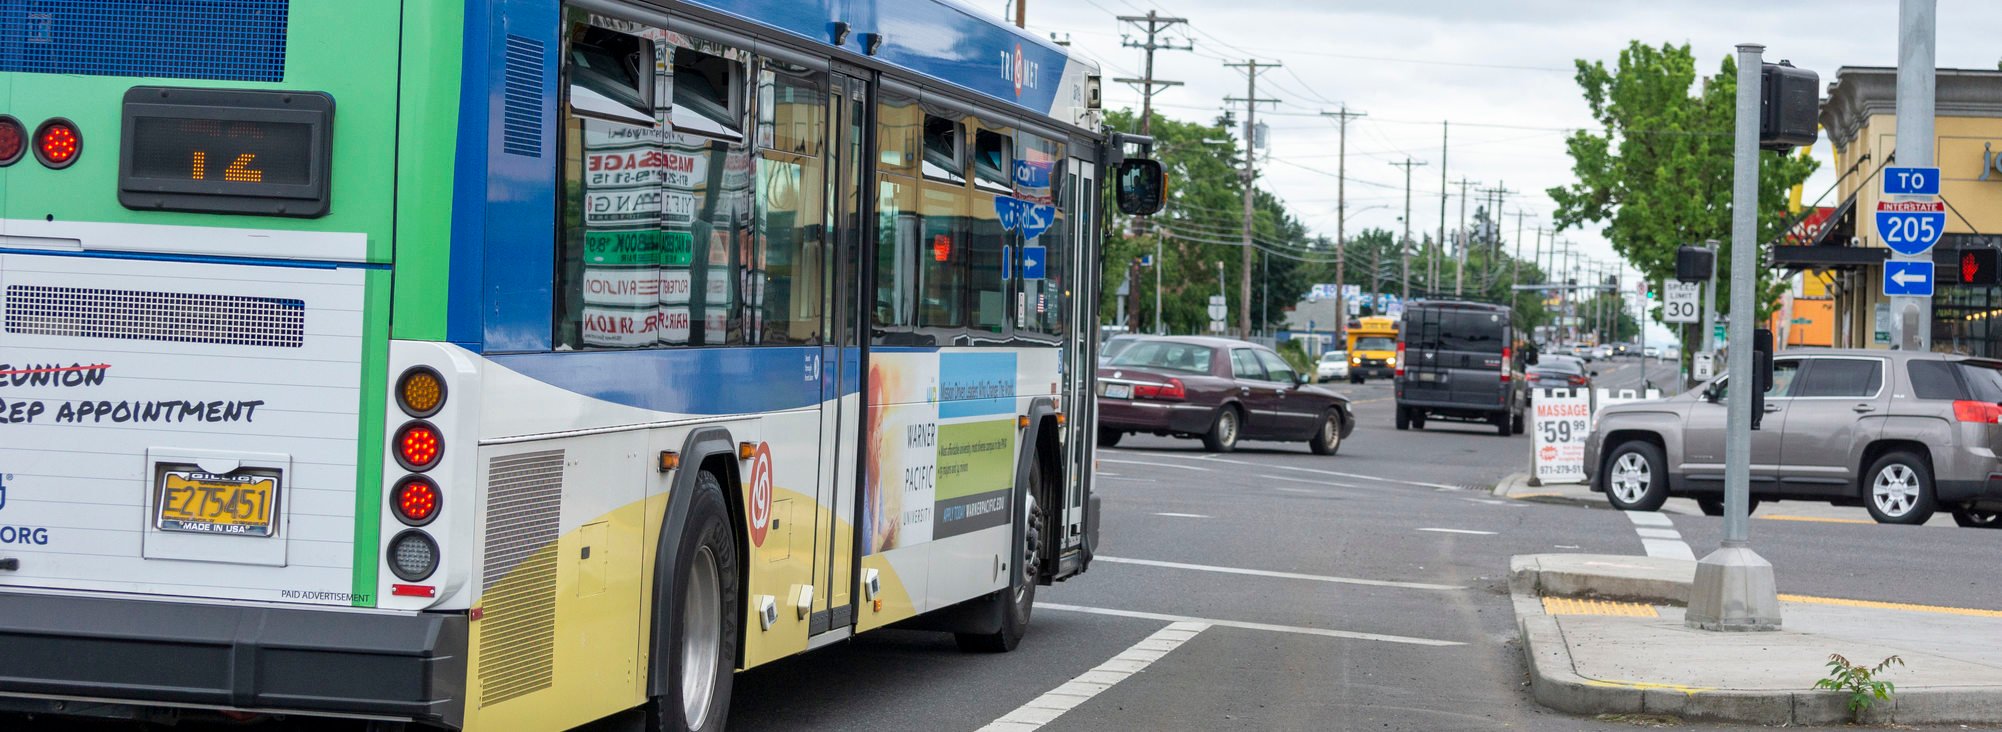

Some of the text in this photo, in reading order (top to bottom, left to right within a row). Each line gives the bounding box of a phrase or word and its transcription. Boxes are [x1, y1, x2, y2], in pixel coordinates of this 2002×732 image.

[1001, 50, 1039, 90] TRI MET
[1977, 142, 2002, 182] j
[1898, 173, 1925, 189] TO
[1883, 204, 1938, 212] INTERSTATE
[1887, 217, 1935, 242] 205
[1668, 302, 1694, 317] 30
[56, 400, 264, 424] APPOINTMENT
[1537, 404, 1588, 416] MASSAGE
[907, 423, 936, 448] WARNER
[905, 465, 934, 492] PACIFIC
[164, 486, 267, 520] E275451
[182, 521, 210, 531] MADE
[213, 523, 223, 532] IN
[226, 525, 246, 534] USA
[281, 589, 370, 603] PAID ADVERTISEMENT
